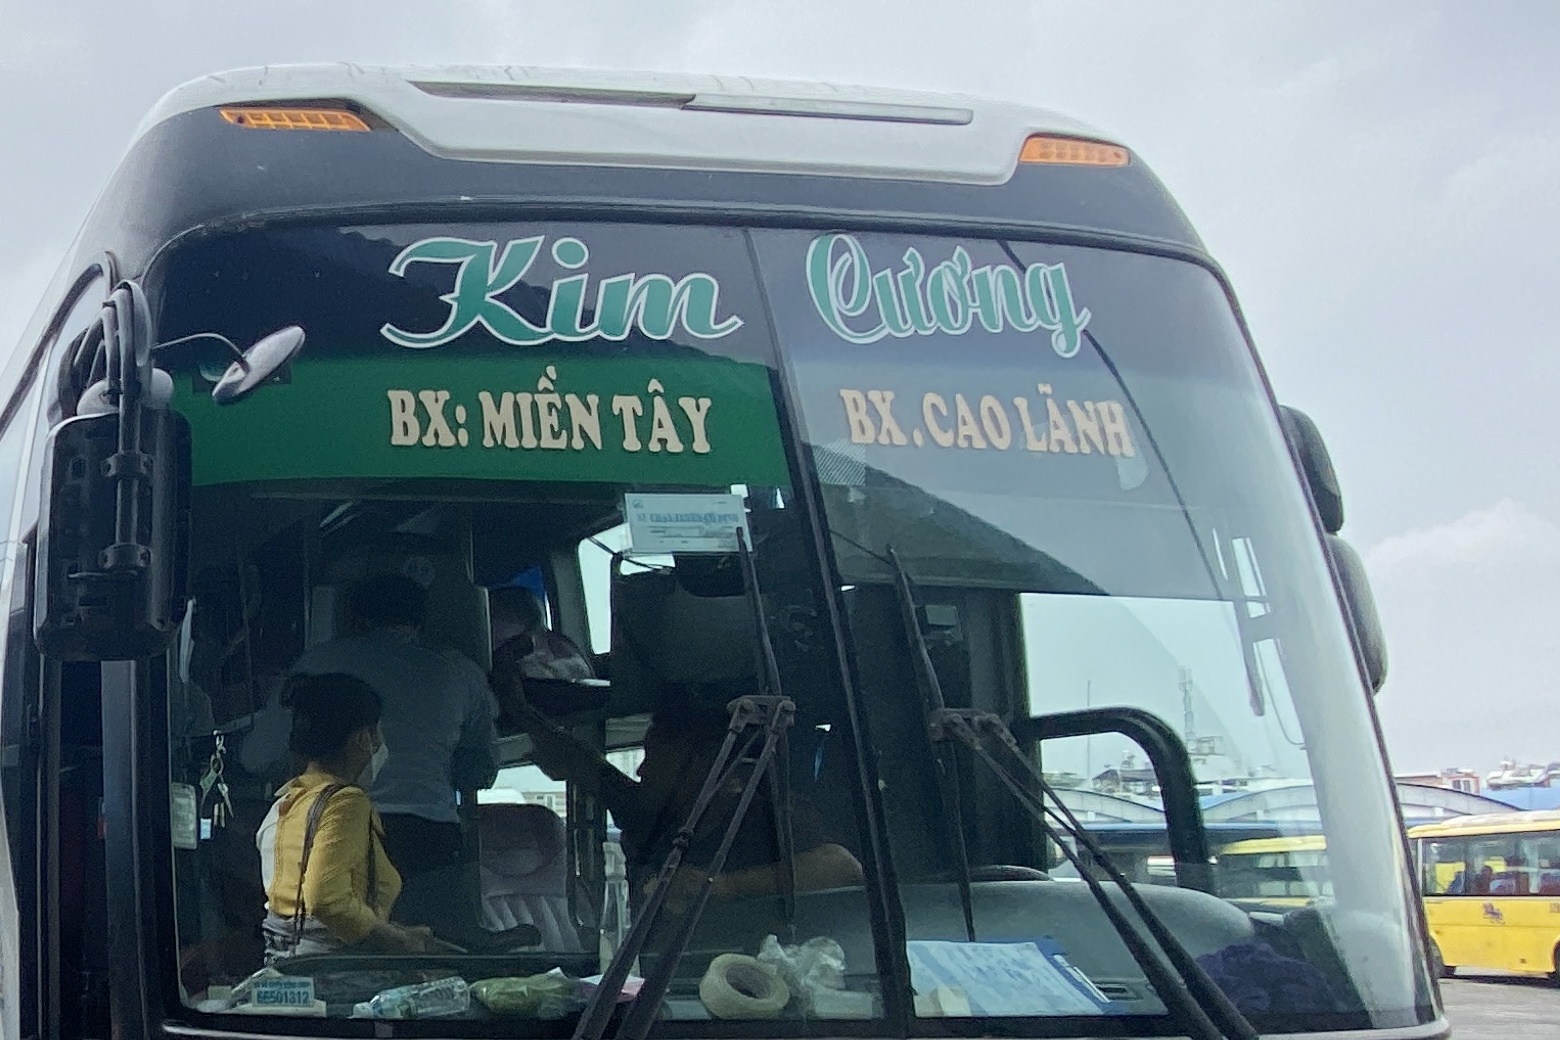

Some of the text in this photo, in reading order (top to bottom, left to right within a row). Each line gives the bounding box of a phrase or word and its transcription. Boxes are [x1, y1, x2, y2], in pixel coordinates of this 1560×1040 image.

[380, 233, 1091, 358] Kim Cương
[387, 365, 712, 453] BX: MIỀN TÂY
[1013, 383, 1135, 458] LÃNH
